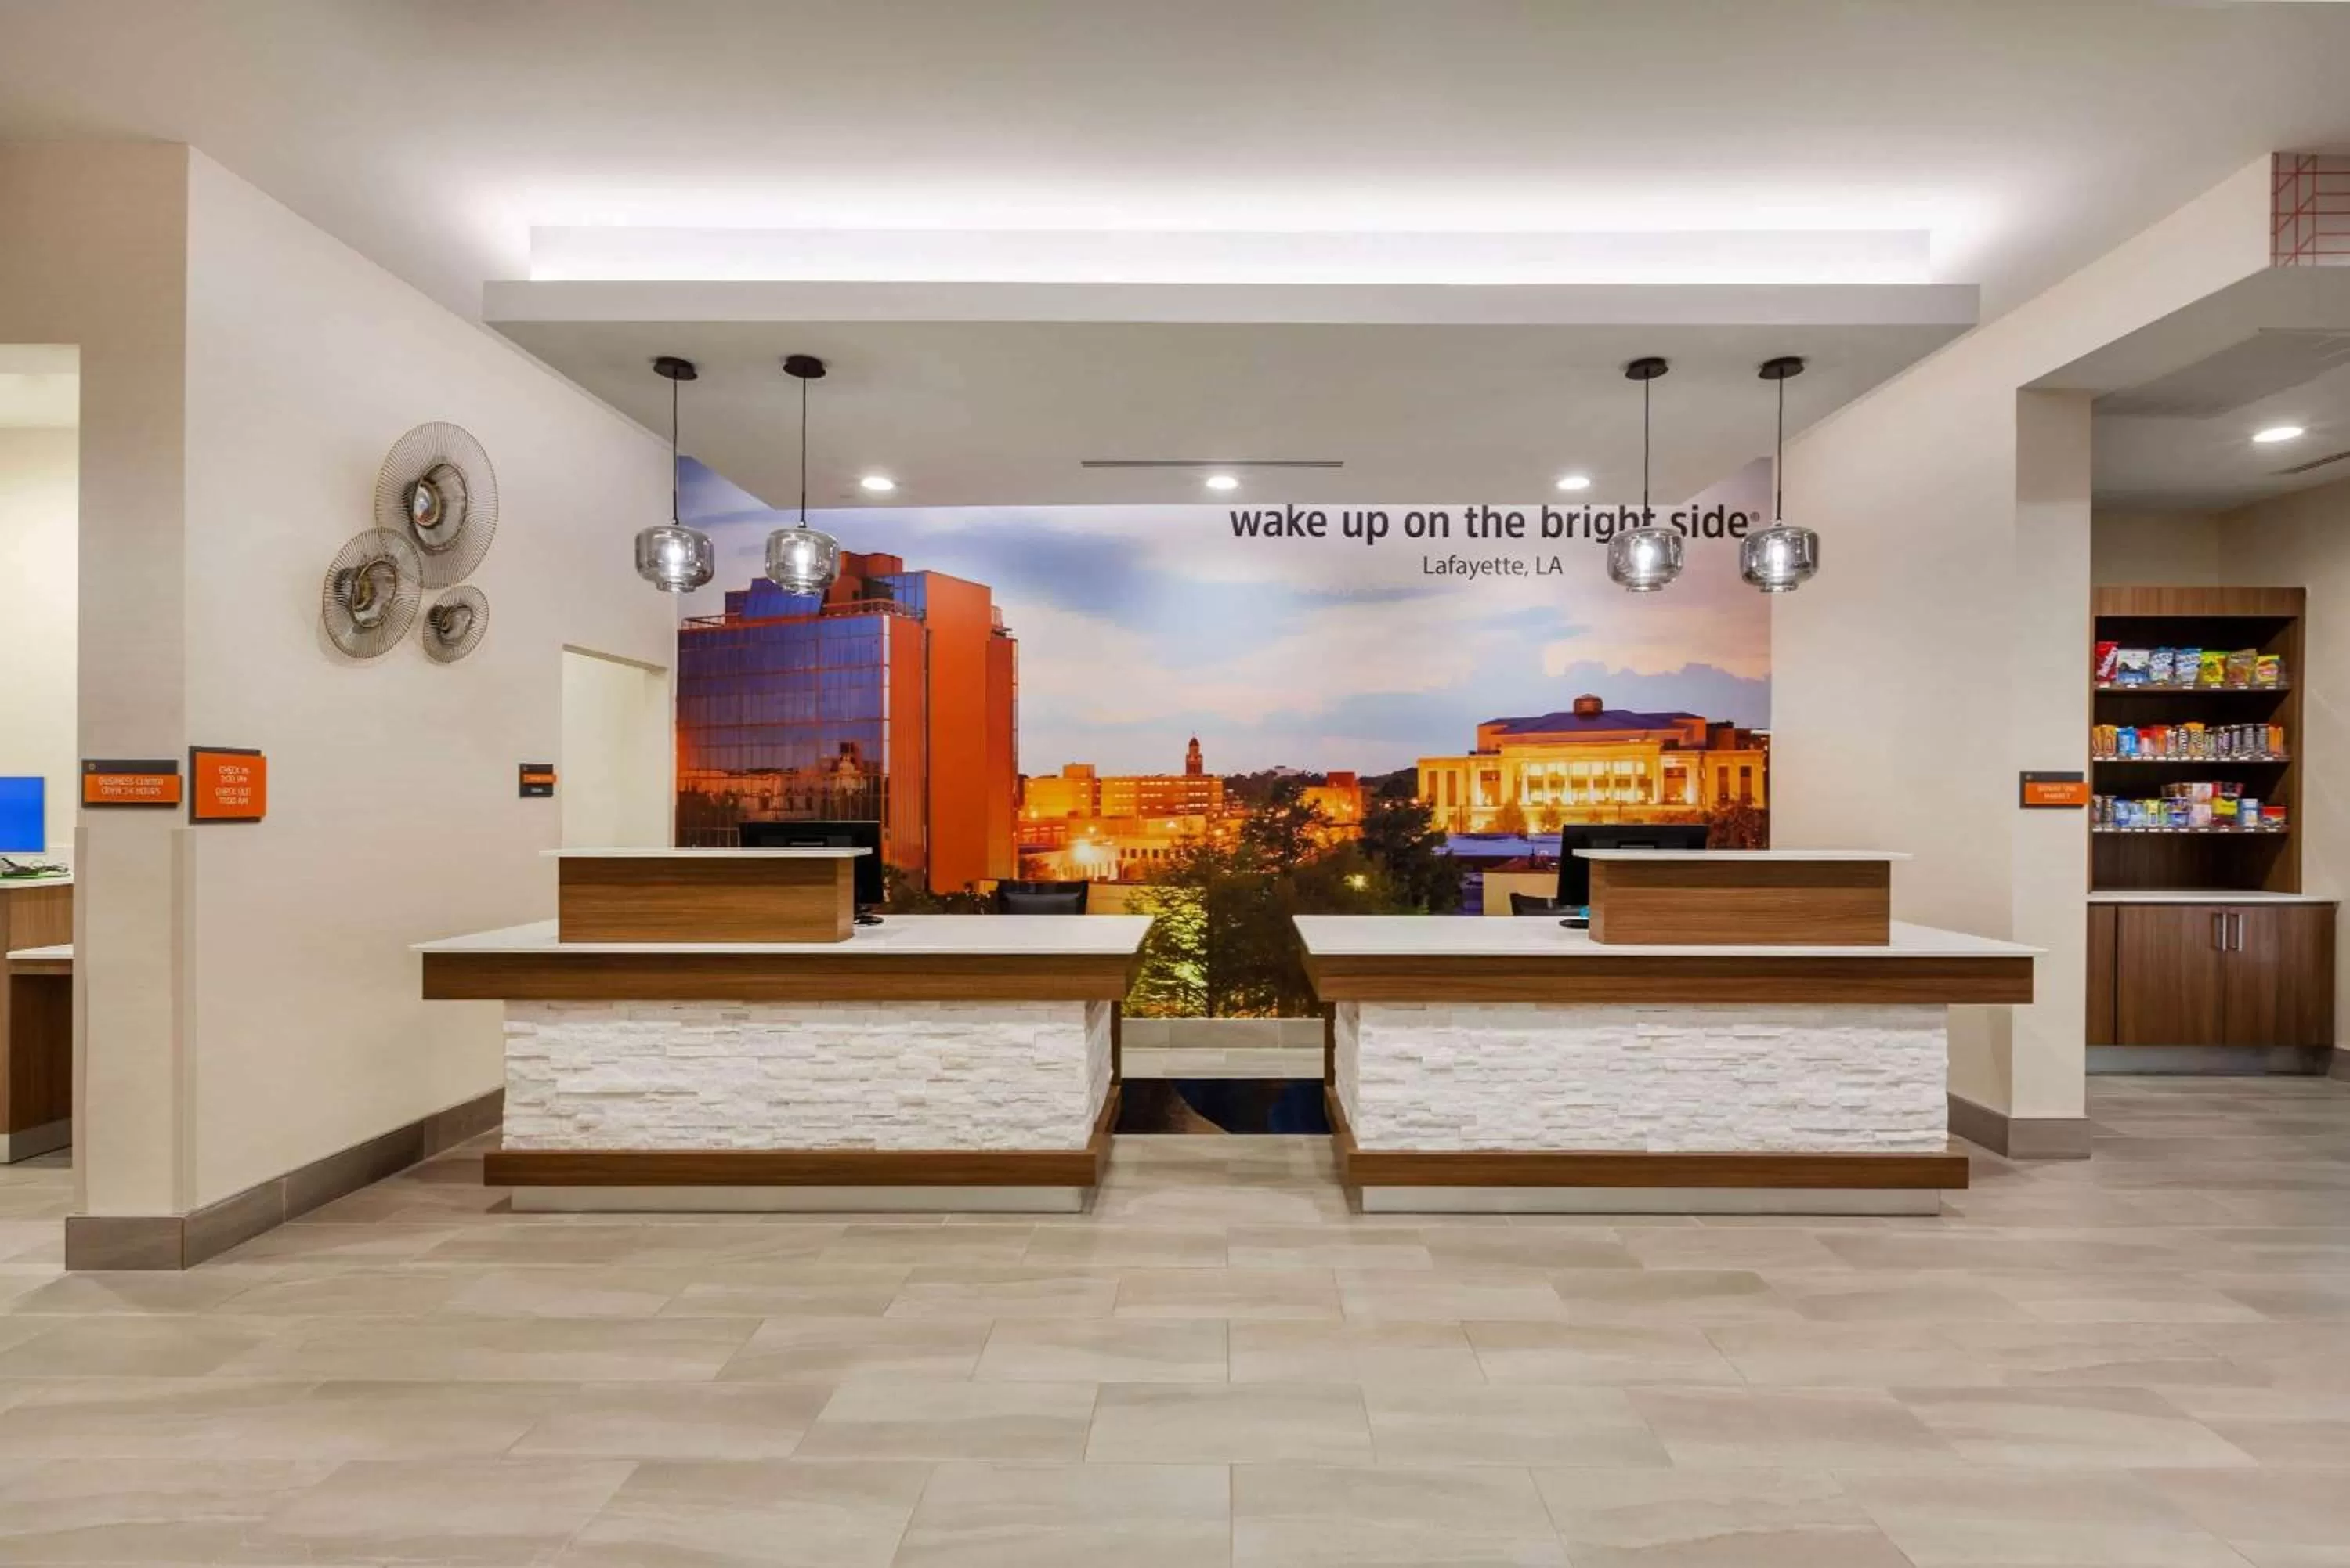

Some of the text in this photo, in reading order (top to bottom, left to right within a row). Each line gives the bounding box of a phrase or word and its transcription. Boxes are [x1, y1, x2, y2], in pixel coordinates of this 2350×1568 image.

[1230, 504, 1327, 537] wake
[1343, 511, 1389, 545] up
[1405, 511, 1449, 538] on
[1464, 504, 1525, 538] the
[1541, 504, 1656, 544] bright
[1423, 555, 1564, 579] Lafayette, LA
